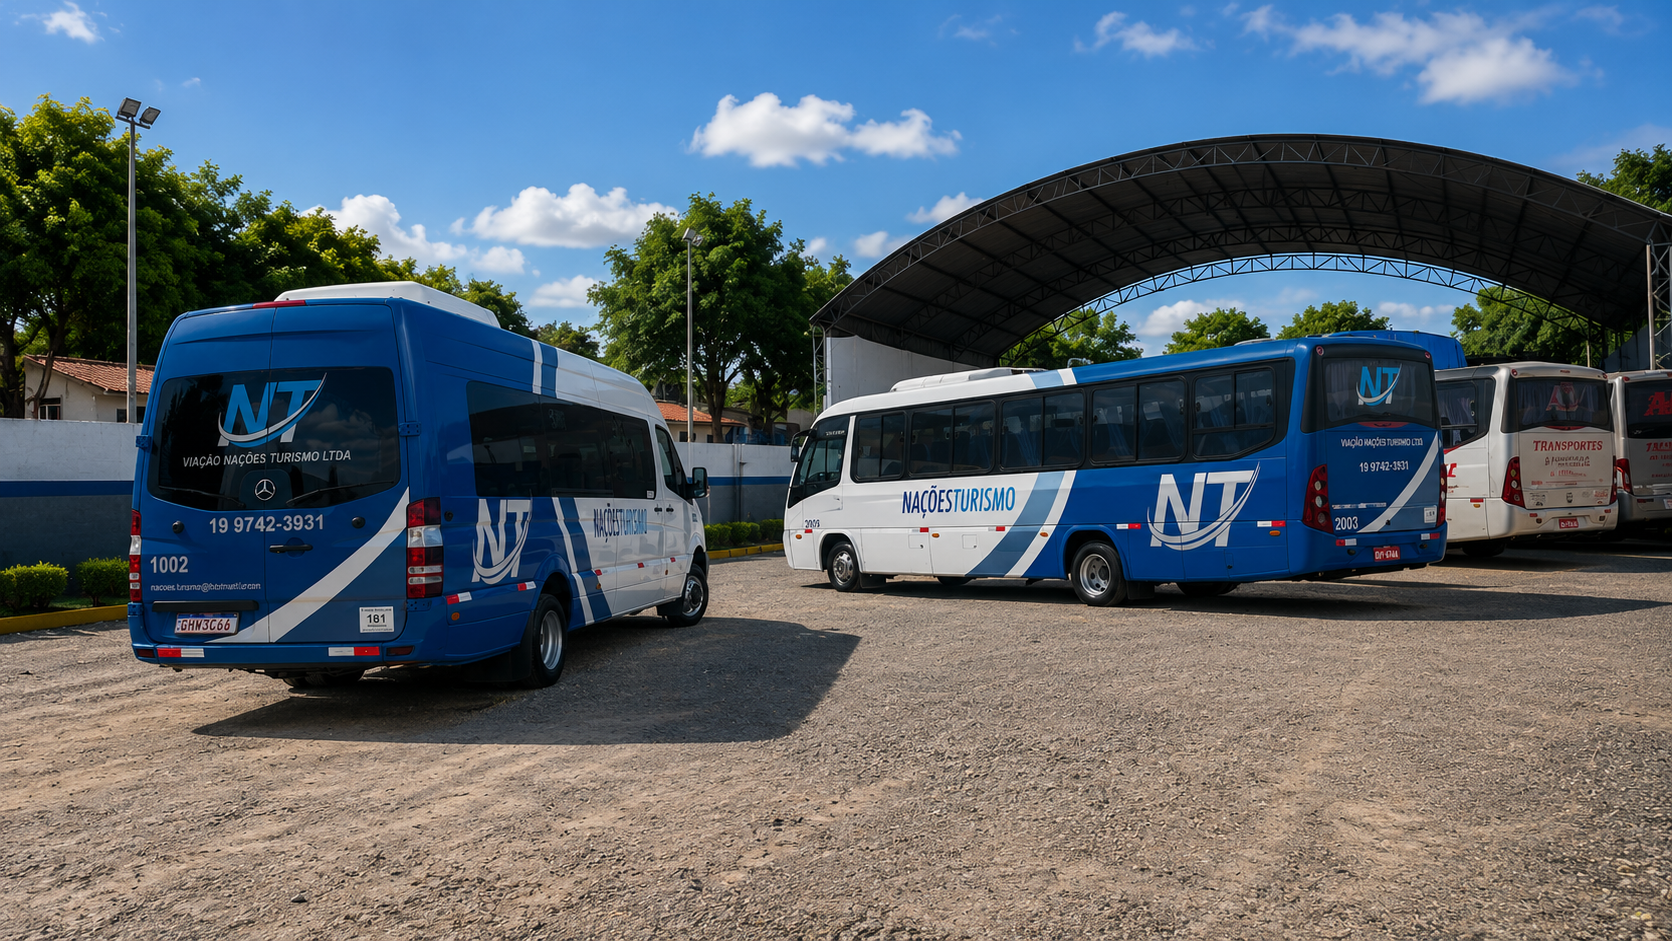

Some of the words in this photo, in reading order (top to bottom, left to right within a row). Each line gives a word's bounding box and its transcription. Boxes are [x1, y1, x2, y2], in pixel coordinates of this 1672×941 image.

[218, 379, 323, 447] NT
[1533, 440, 1603, 452] TRANSPORTES
[182, 453, 221, 469] VIAÇÃO
[223, 451, 267, 467] NAÇÕES
[269, 451, 320, 464] TURISMO
[322, 450, 352, 462] LTDA
[1359, 462, 1369, 473] 19
[1149, 467, 1256, 549] NT
[209, 517, 229, 534] 19
[233, 514, 324, 533] 9742-3931
[1335, 516, 1359, 531] 2003
[471, 497, 531, 583] NT
[150, 556, 189, 574] 1002
[366, 613, 386, 624] 181
